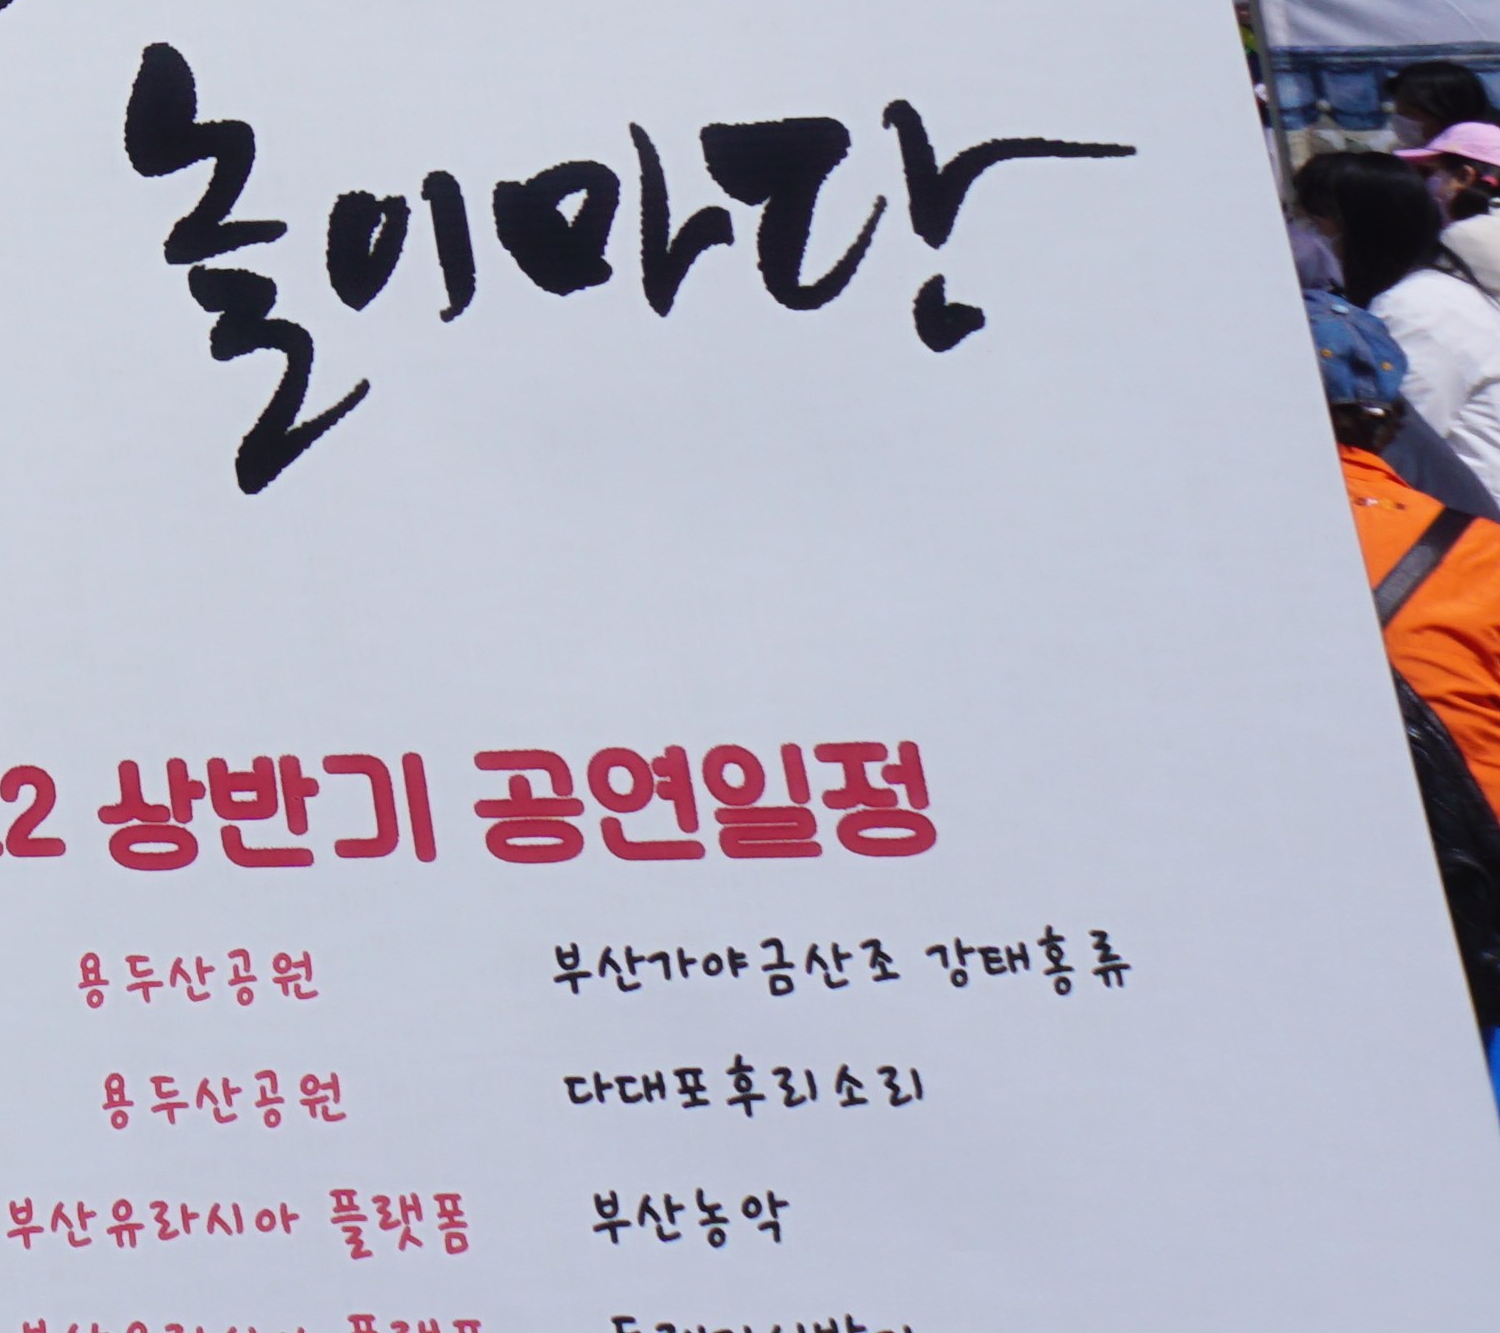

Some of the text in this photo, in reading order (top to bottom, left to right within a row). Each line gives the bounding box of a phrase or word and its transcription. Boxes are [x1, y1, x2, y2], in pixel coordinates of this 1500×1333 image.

[123, 42, 1137, 495] 놀이마당
[98, 751, 438, 873] 상반기
[473, 740, 938, 865] 공연일정
[77, 948, 320, 1010] 용두산공원
[552, 936, 902, 998] 부산가야금산조
[924, 924, 1132, 997] 강태홍류
[102, 1069, 348, 1130] 용두산공원
[562, 1052, 925, 1119] 다대포후리소리
[6, 1197, 300, 1250] 부산유라시아
[329, 1187, 471, 1260] 플랫폼
[592, 1187, 791, 1250] 부산농악
